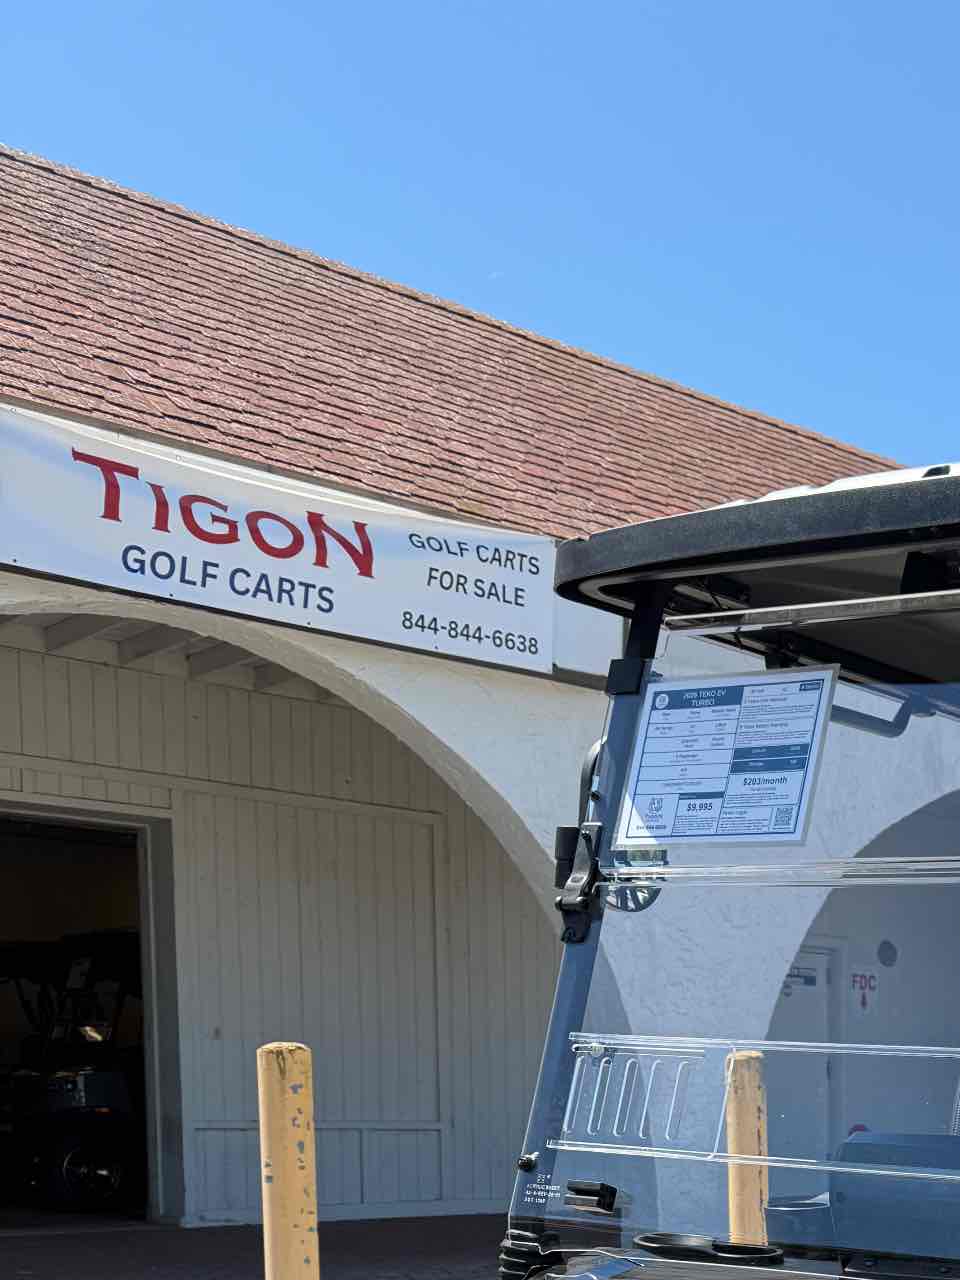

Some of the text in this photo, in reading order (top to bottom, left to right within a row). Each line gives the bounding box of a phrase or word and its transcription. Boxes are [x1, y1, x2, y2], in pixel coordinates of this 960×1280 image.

[71, 447, 375, 578] TIGON
[408, 533, 540, 575] GOLF CARTS
[121, 544, 335, 613] GOLF CARTS
[427, 567, 526, 607] FOR SALE
[402, 611, 538, 654] 844-844-6638
[851, 974, 877, 991] FDC
